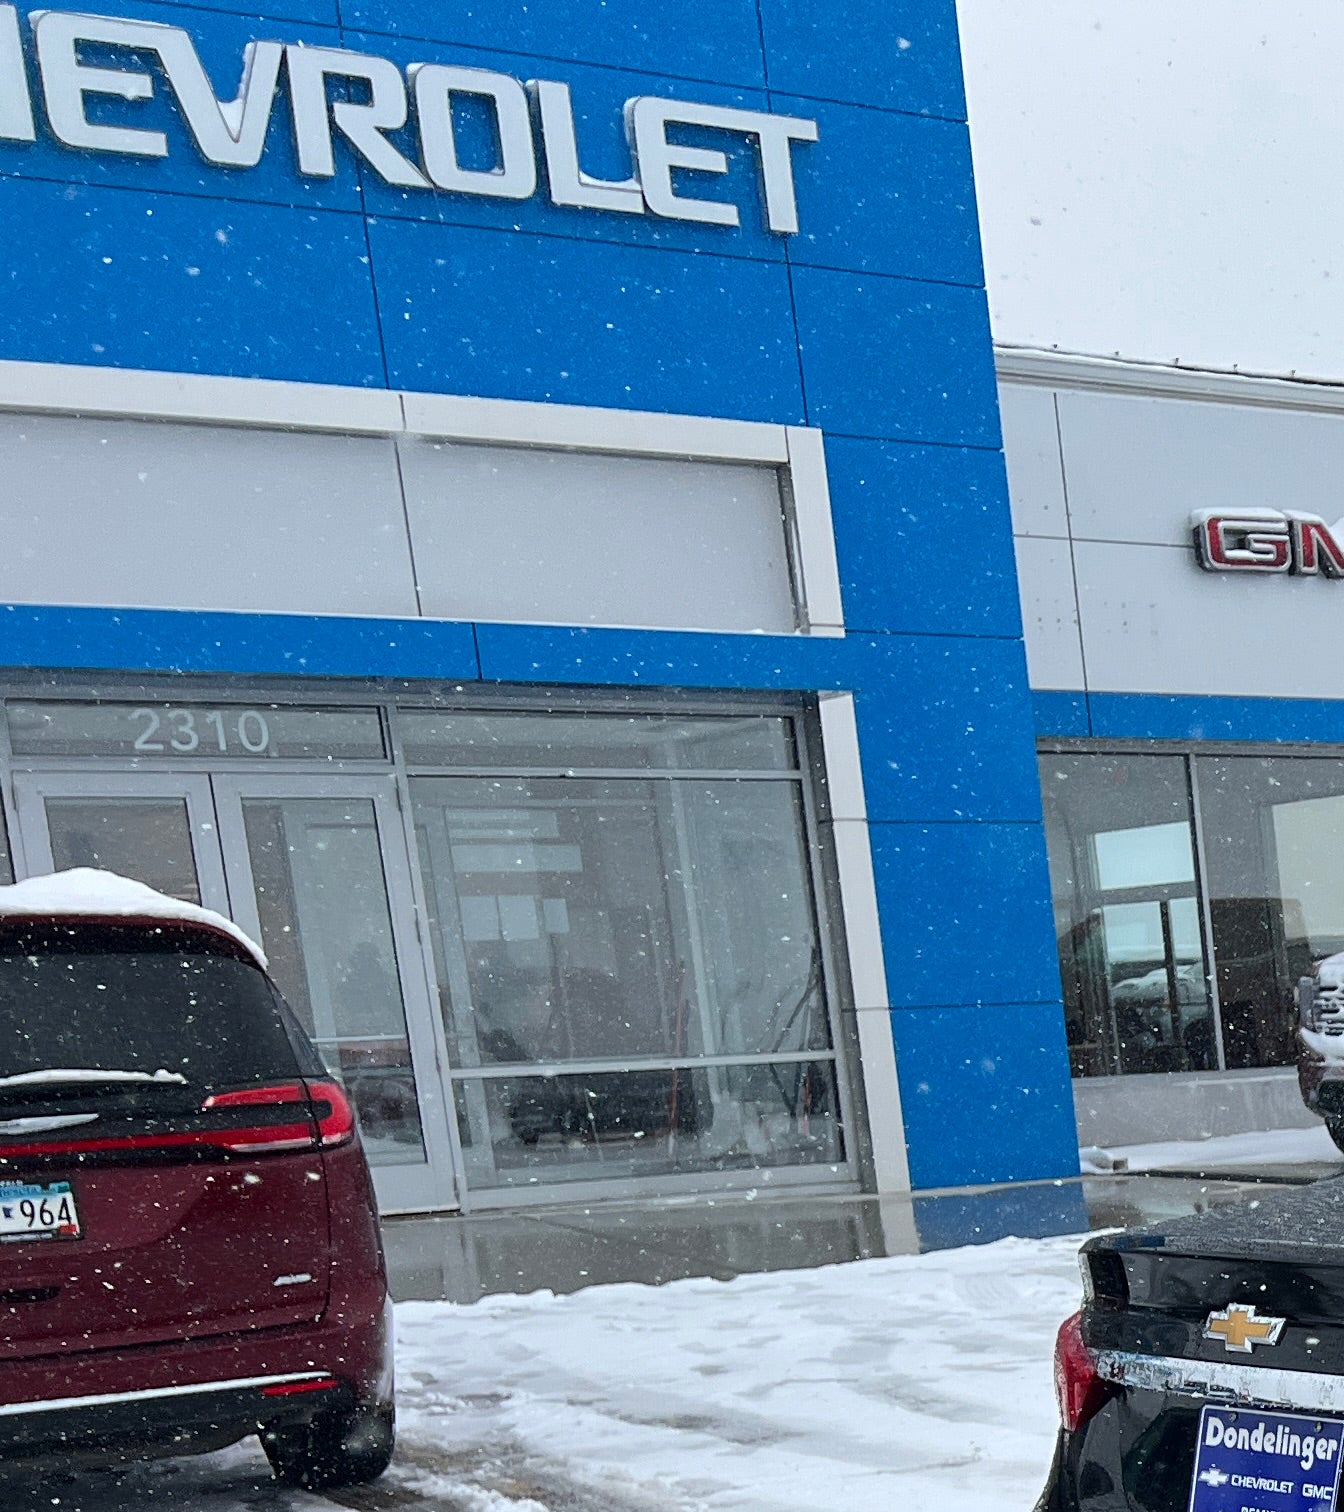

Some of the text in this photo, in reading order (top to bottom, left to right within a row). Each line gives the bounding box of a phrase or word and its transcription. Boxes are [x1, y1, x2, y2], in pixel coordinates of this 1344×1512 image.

[128, 707, 269, 752] 2310
[20, 1197, 72, 1227] 964
[1204, 1416, 1338, 1471] Dondelinger
[1231, 1474, 1334, 1500] CHEVROLET GMC
